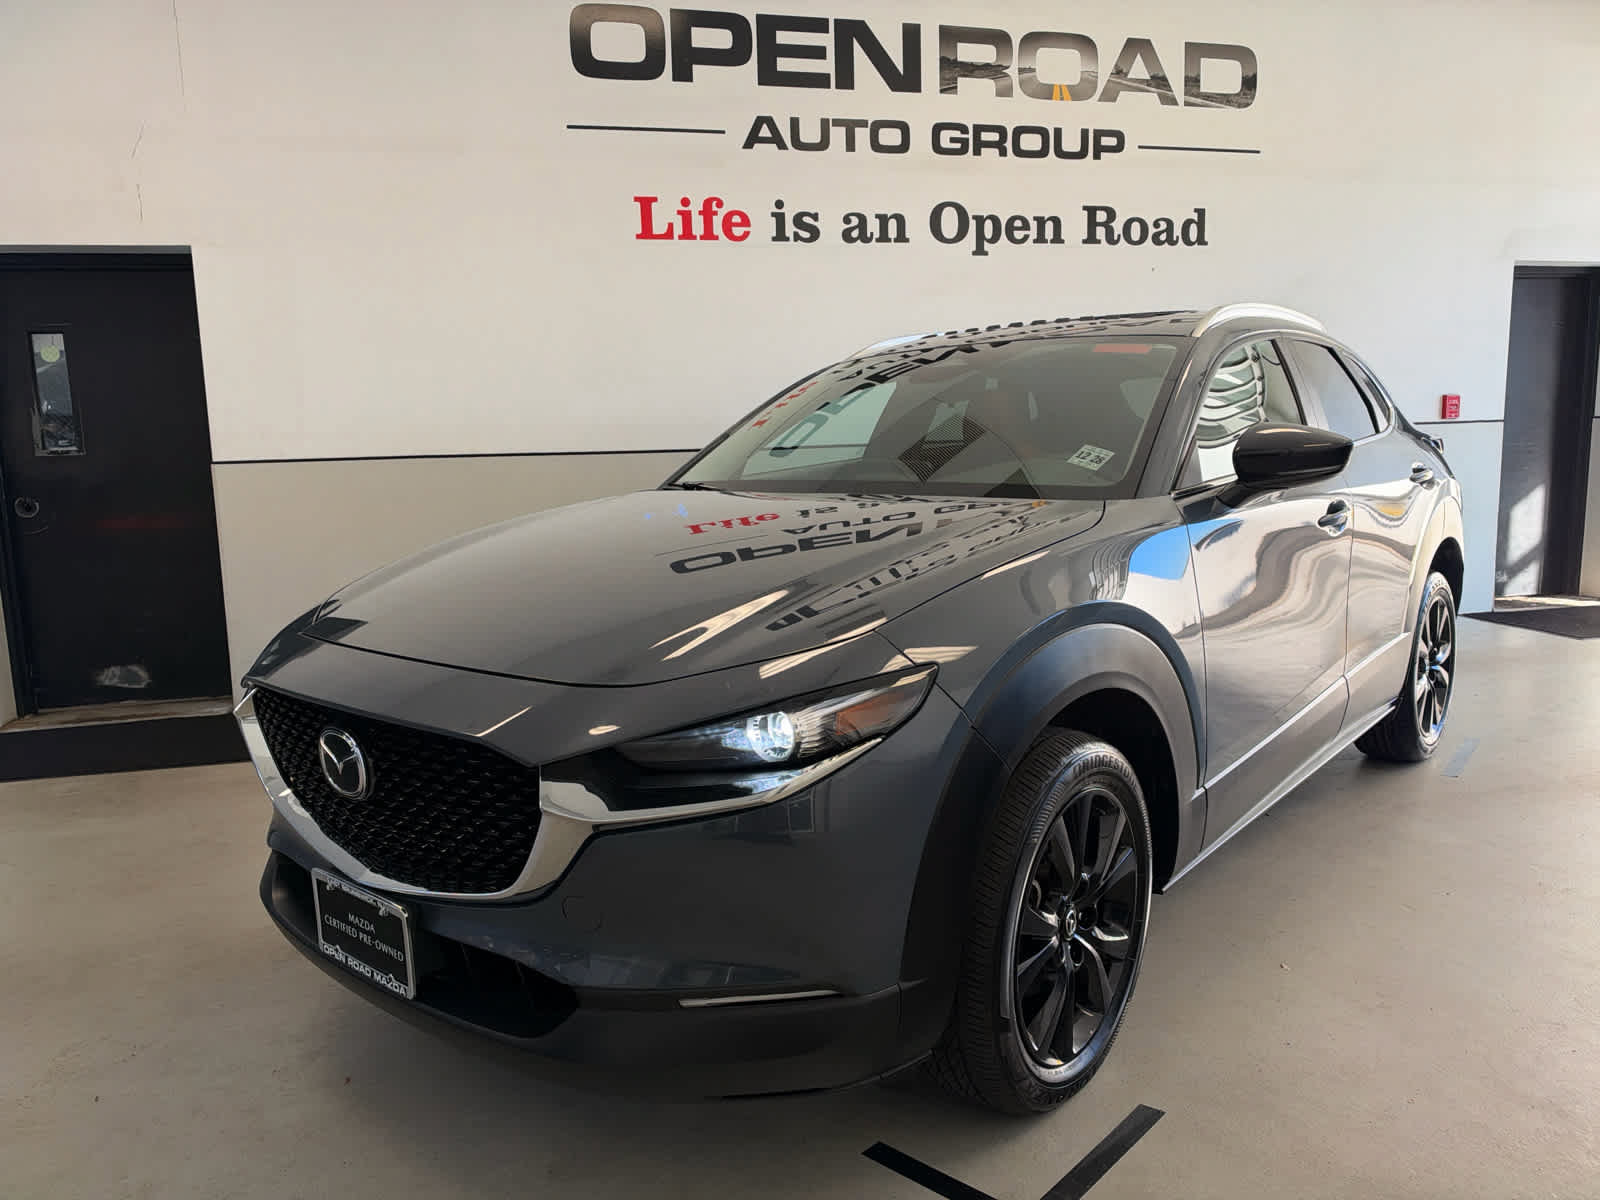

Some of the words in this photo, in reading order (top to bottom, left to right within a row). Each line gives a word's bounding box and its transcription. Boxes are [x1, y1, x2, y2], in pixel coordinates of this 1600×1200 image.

[570, 3, 922, 93] OPEN
[939, 24, 1258, 109] ROAD
[742, 115, 911, 154] AUTO
[931, 121, 1126, 160] GROUP
[634, 196, 752, 241] Life
[771, 199, 820, 242] is
[842, 210, 909, 243] an
[929, 201, 1063, 255] Open
[1083, 206, 1209, 247] Road
[324, 914, 358, 938] CERTIFIED
[359, 933, 404, 961] PRE-OWNED
[347, 912, 376, 934] MAZDA
[347, 959, 372, 977] ROAD
